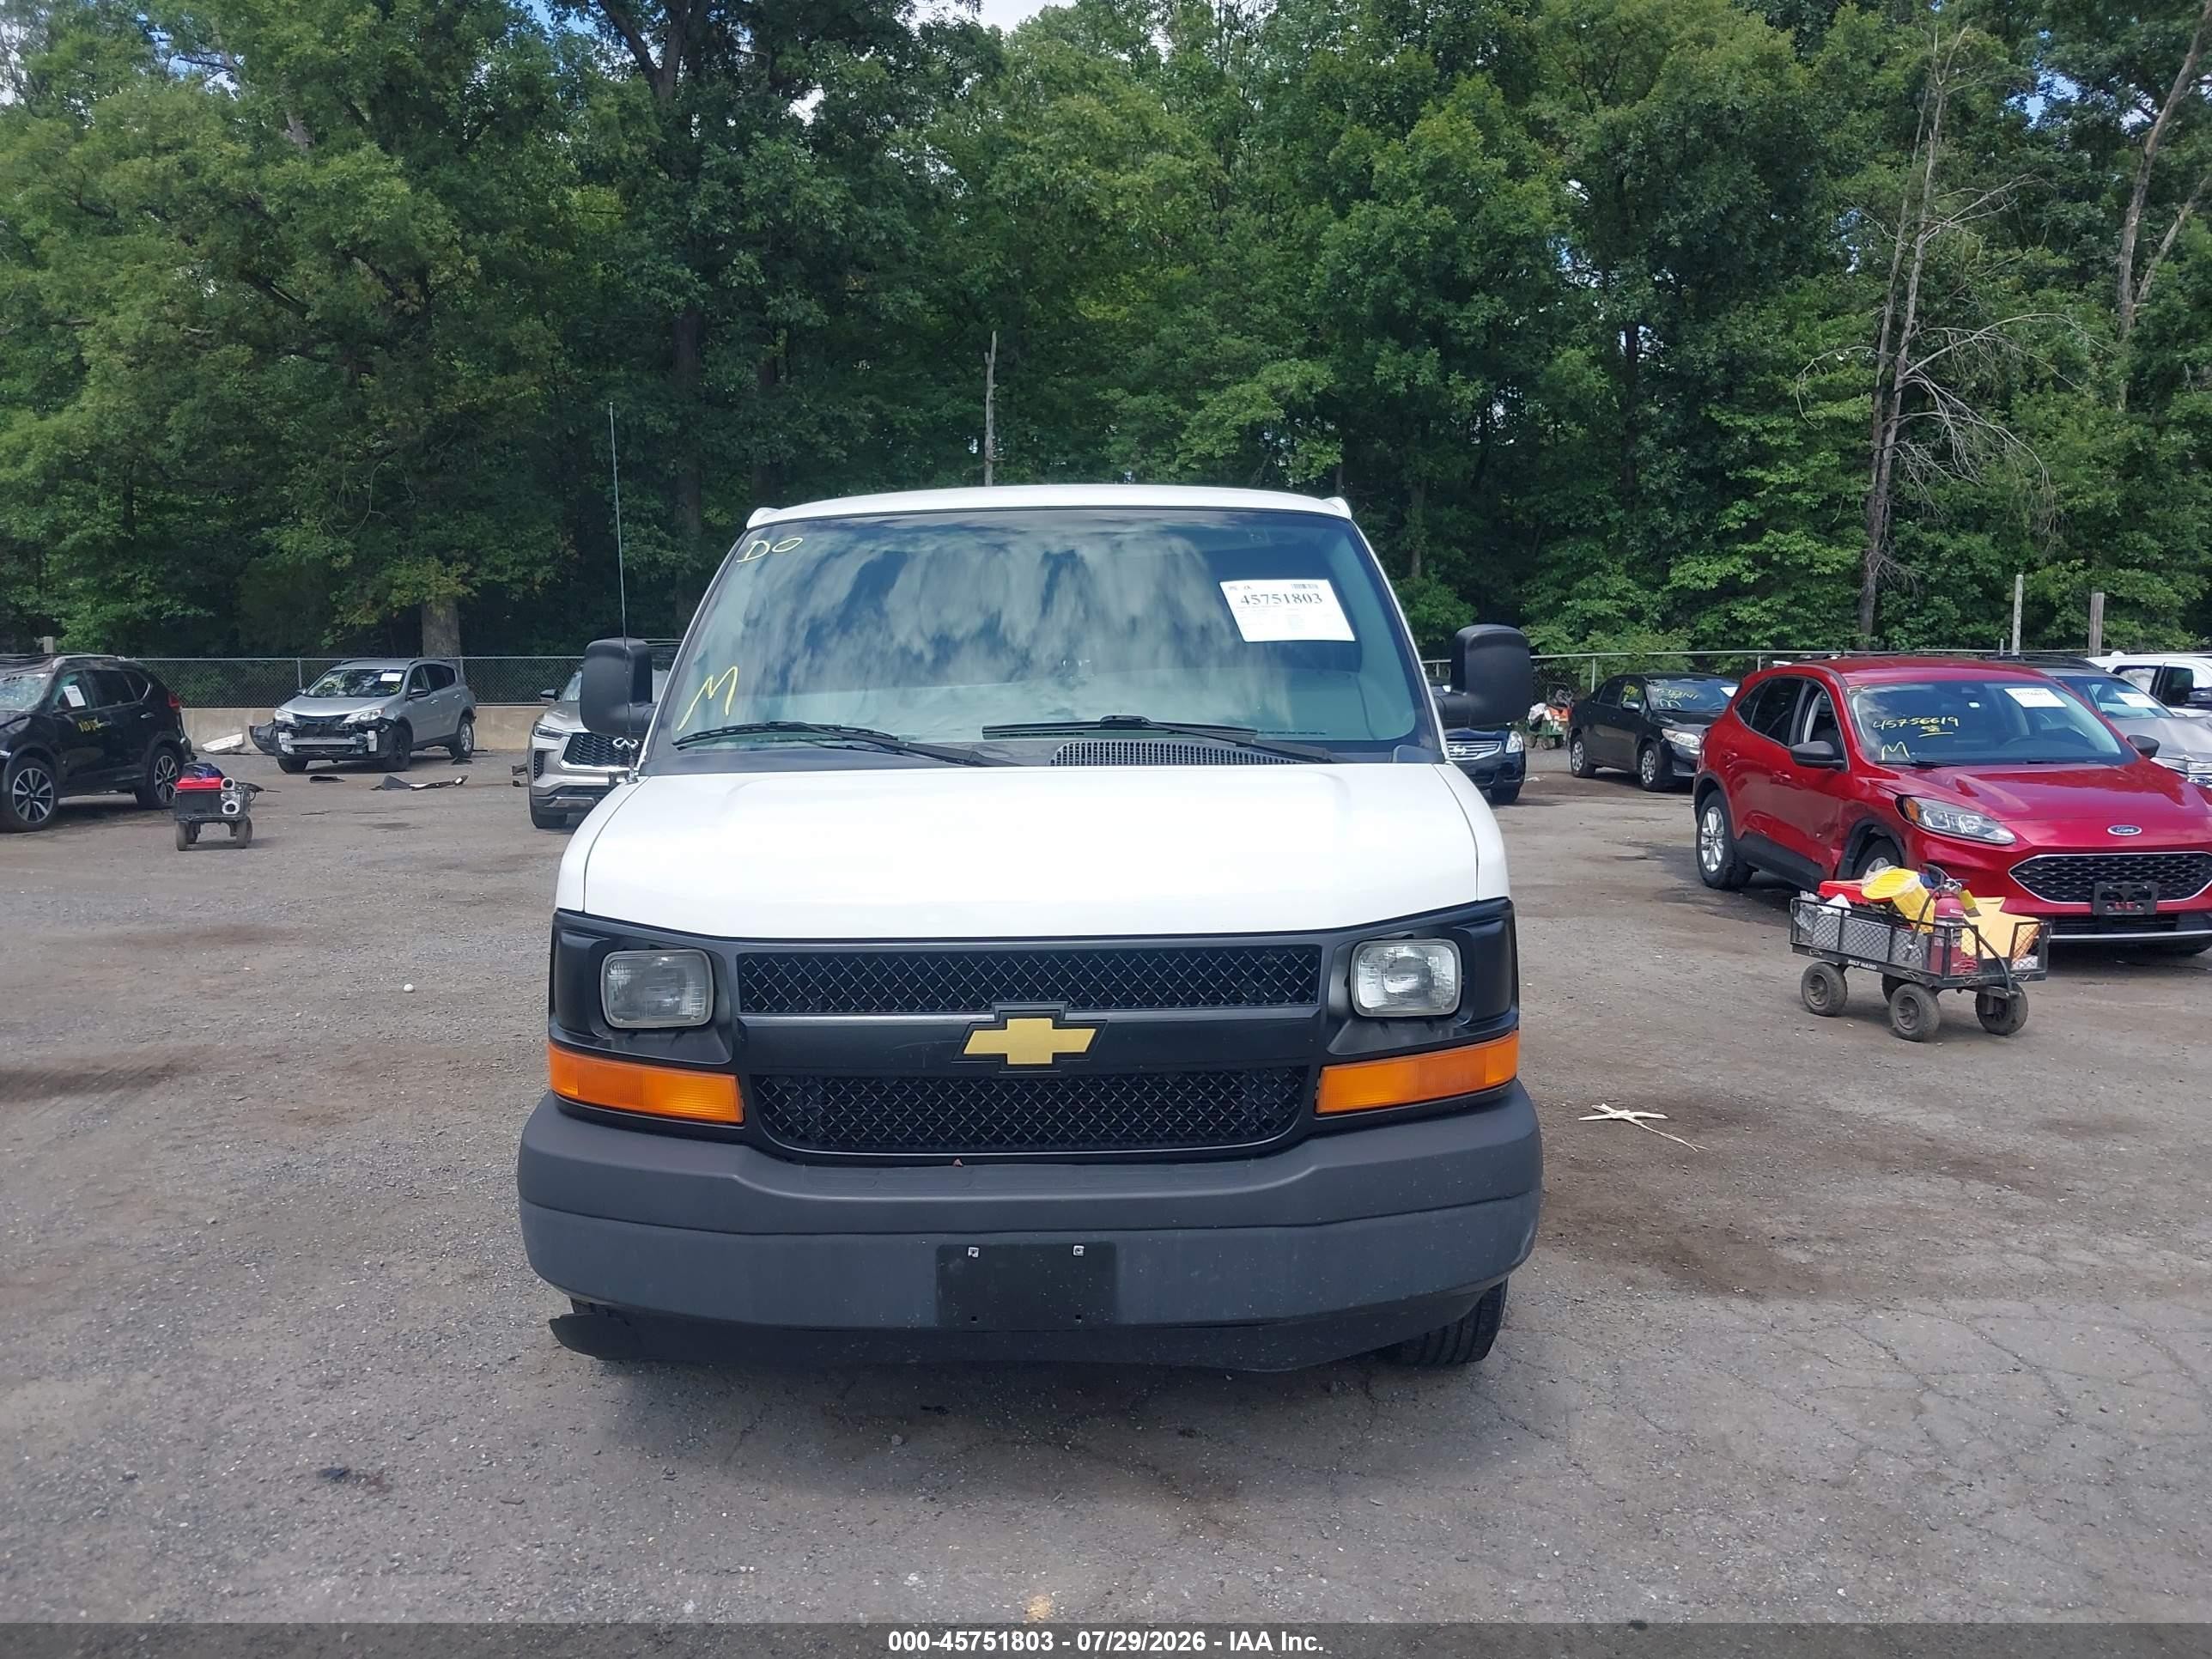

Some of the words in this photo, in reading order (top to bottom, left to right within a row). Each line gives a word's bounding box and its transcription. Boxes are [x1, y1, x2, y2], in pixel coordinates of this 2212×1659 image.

[1241, 592, 1323, 605] 45751803
[677, 665, 739, 732] M
[1873, 715, 1960, 731] 45756619
[1881, 740, 1911, 761] M
